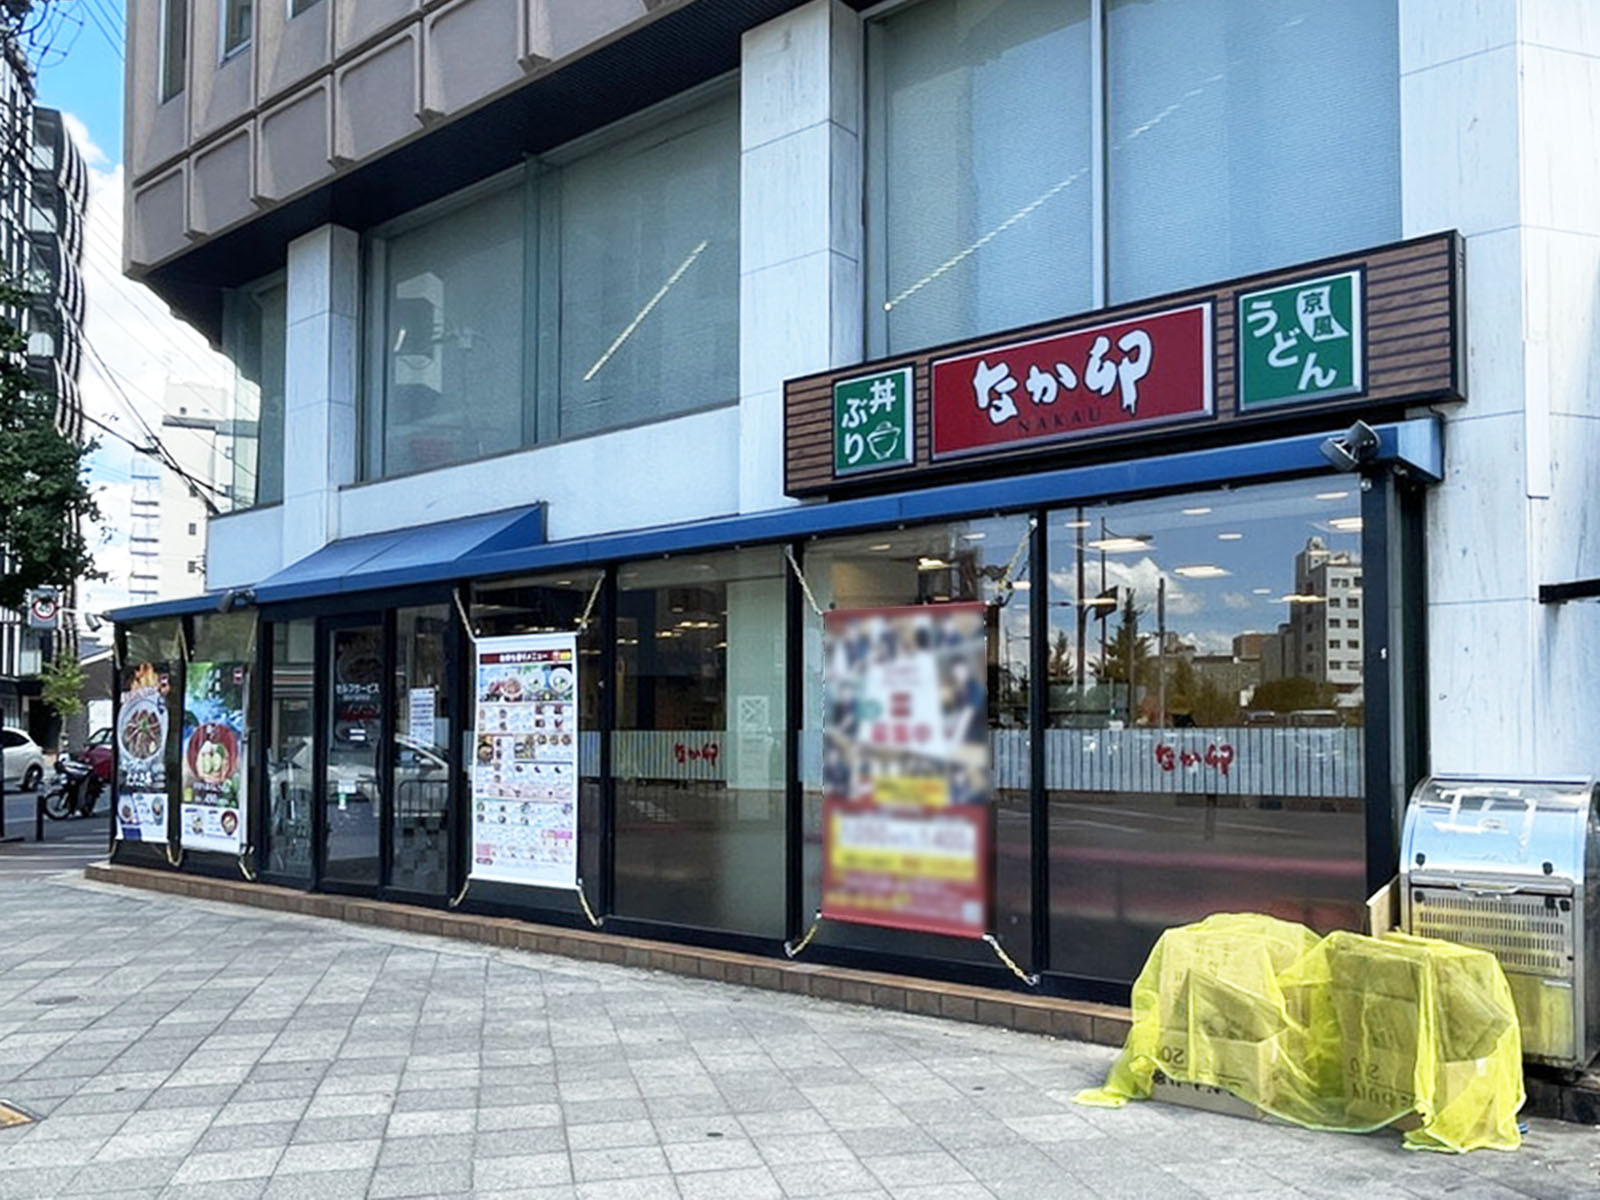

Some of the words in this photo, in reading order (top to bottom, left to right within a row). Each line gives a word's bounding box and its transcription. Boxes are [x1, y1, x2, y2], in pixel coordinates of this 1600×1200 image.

[1246, 299, 1337, 392] うどん
[973, 329, 1153, 425] なか卯
[1018, 408, 1101, 432] NAKAU
[674, 742, 719, 767] なか卯
[1155, 744, 1234, 776] なか卯
